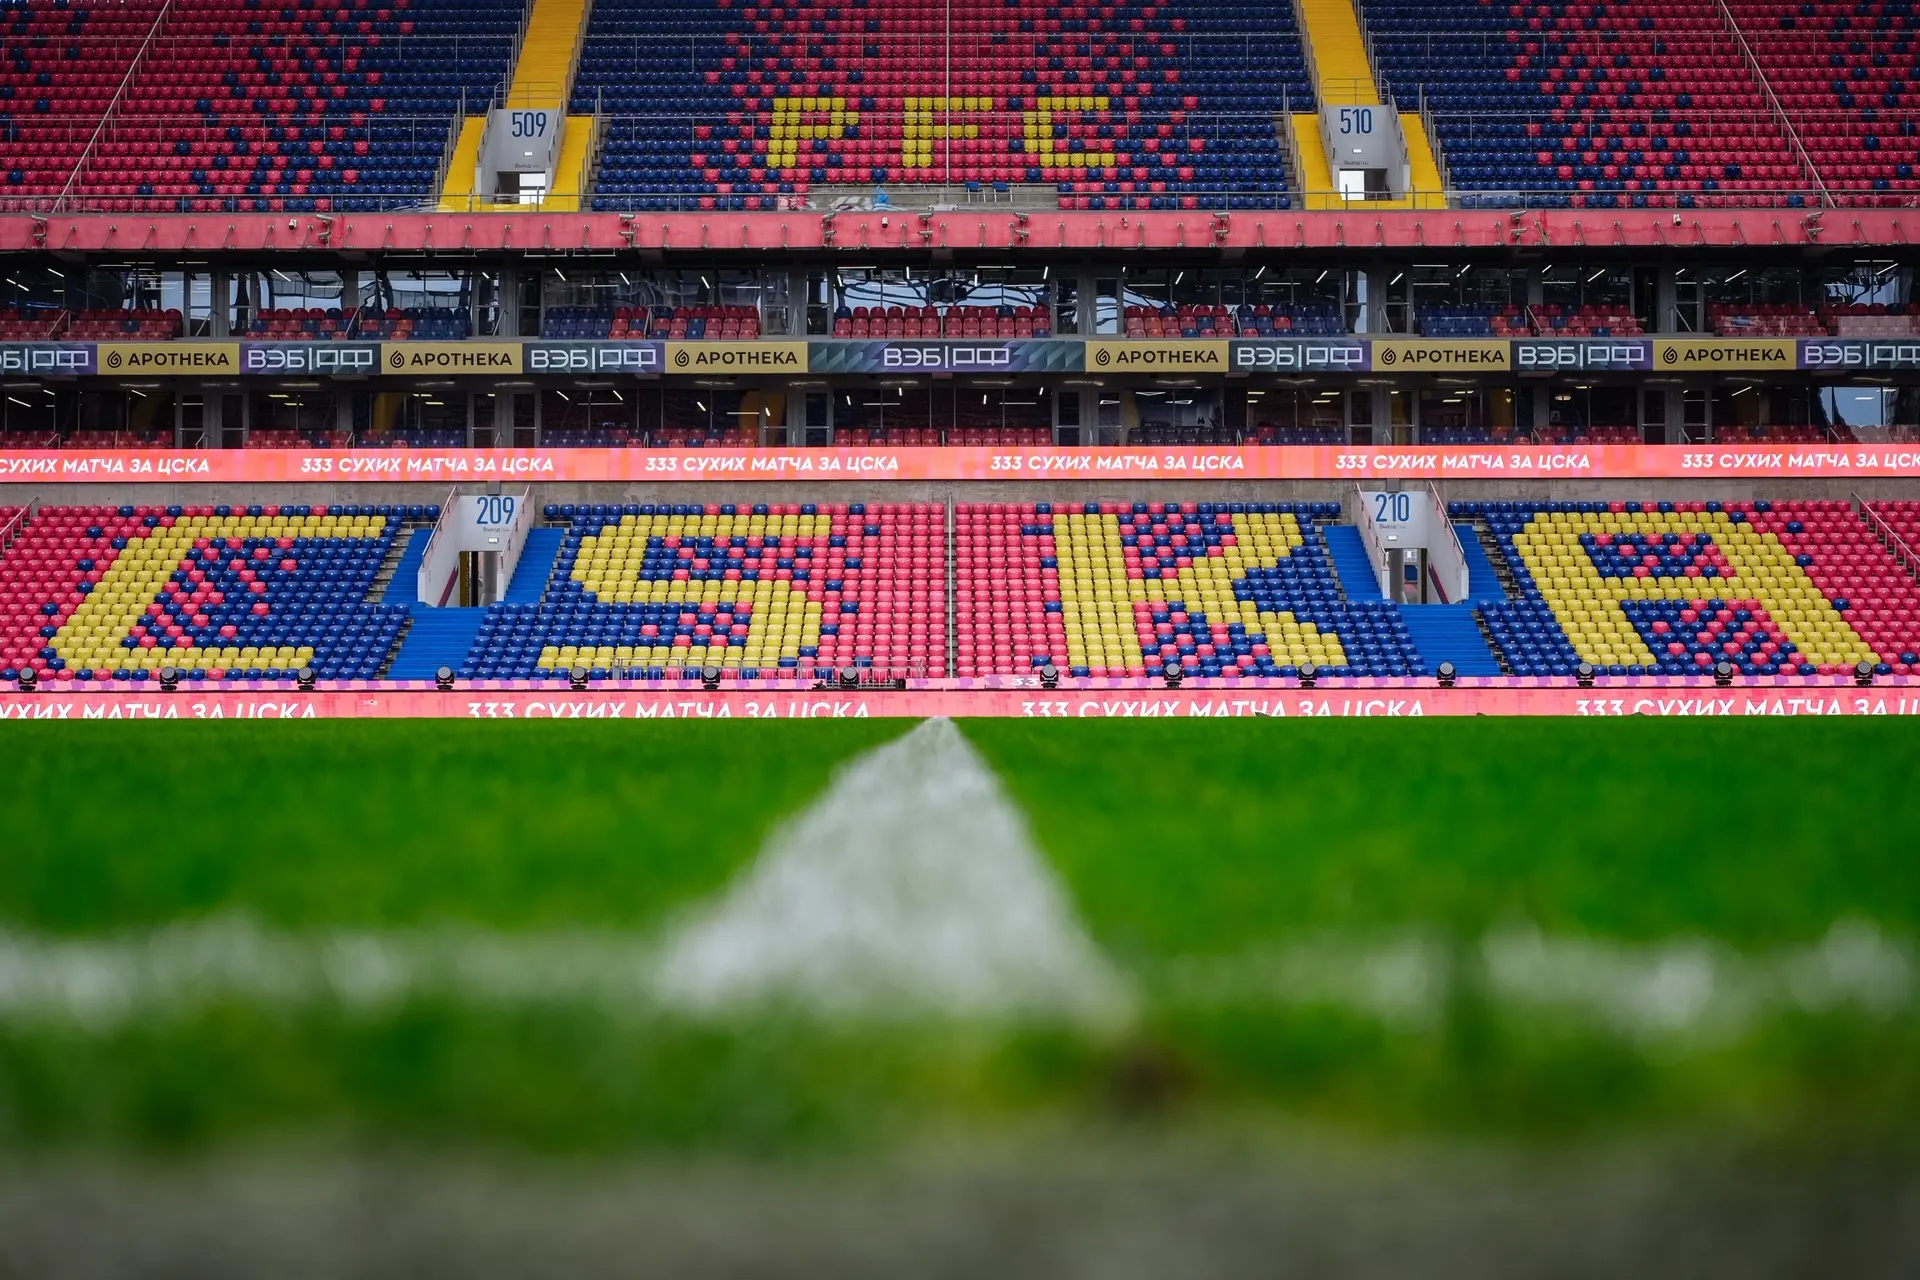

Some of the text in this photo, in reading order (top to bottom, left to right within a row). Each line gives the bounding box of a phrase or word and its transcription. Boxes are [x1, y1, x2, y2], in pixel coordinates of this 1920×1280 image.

[512, 112, 547, 138] 509
[1340, 108, 1372, 134] 510
[128, 352, 229, 366] APOTHEKA
[411, 352, 513, 366] APOTHEKA
[695, 351, 798, 365] APOTHEKA
[1116, 350, 1219, 364] APOTHEKA
[1402, 349, 1505, 363] APOTHEKA
[1683, 348, 1787, 362] APOTHEKA
[64, 459, 124, 472] МАТЧА
[130, 459, 152, 472] ЗА
[157, 459, 209, 475] ЦСКА
[301, 458, 554, 474] 333 СУХИХ МАТЧА ЗА ЦСКА
[645, 457, 899, 473] 333 СУХИХ МАТЧА ЗА ЦСКА
[991, 456, 1244, 472] 333 СУХИХ МАТЧА ЗА ЦСКА
[1336, 455, 1590, 471] 333 СУХИХ МАТЧА ЗА ЦСКА
[1682, 454, 1713, 468] 333
[1719, 454, 1782, 467] СУХИХ
[1788, 454, 1850, 467] МАТЧА
[1856, 453, 1878, 467] ЗА
[476, 496, 515, 525] 209
[1375, 493, 1410, 522] 210
